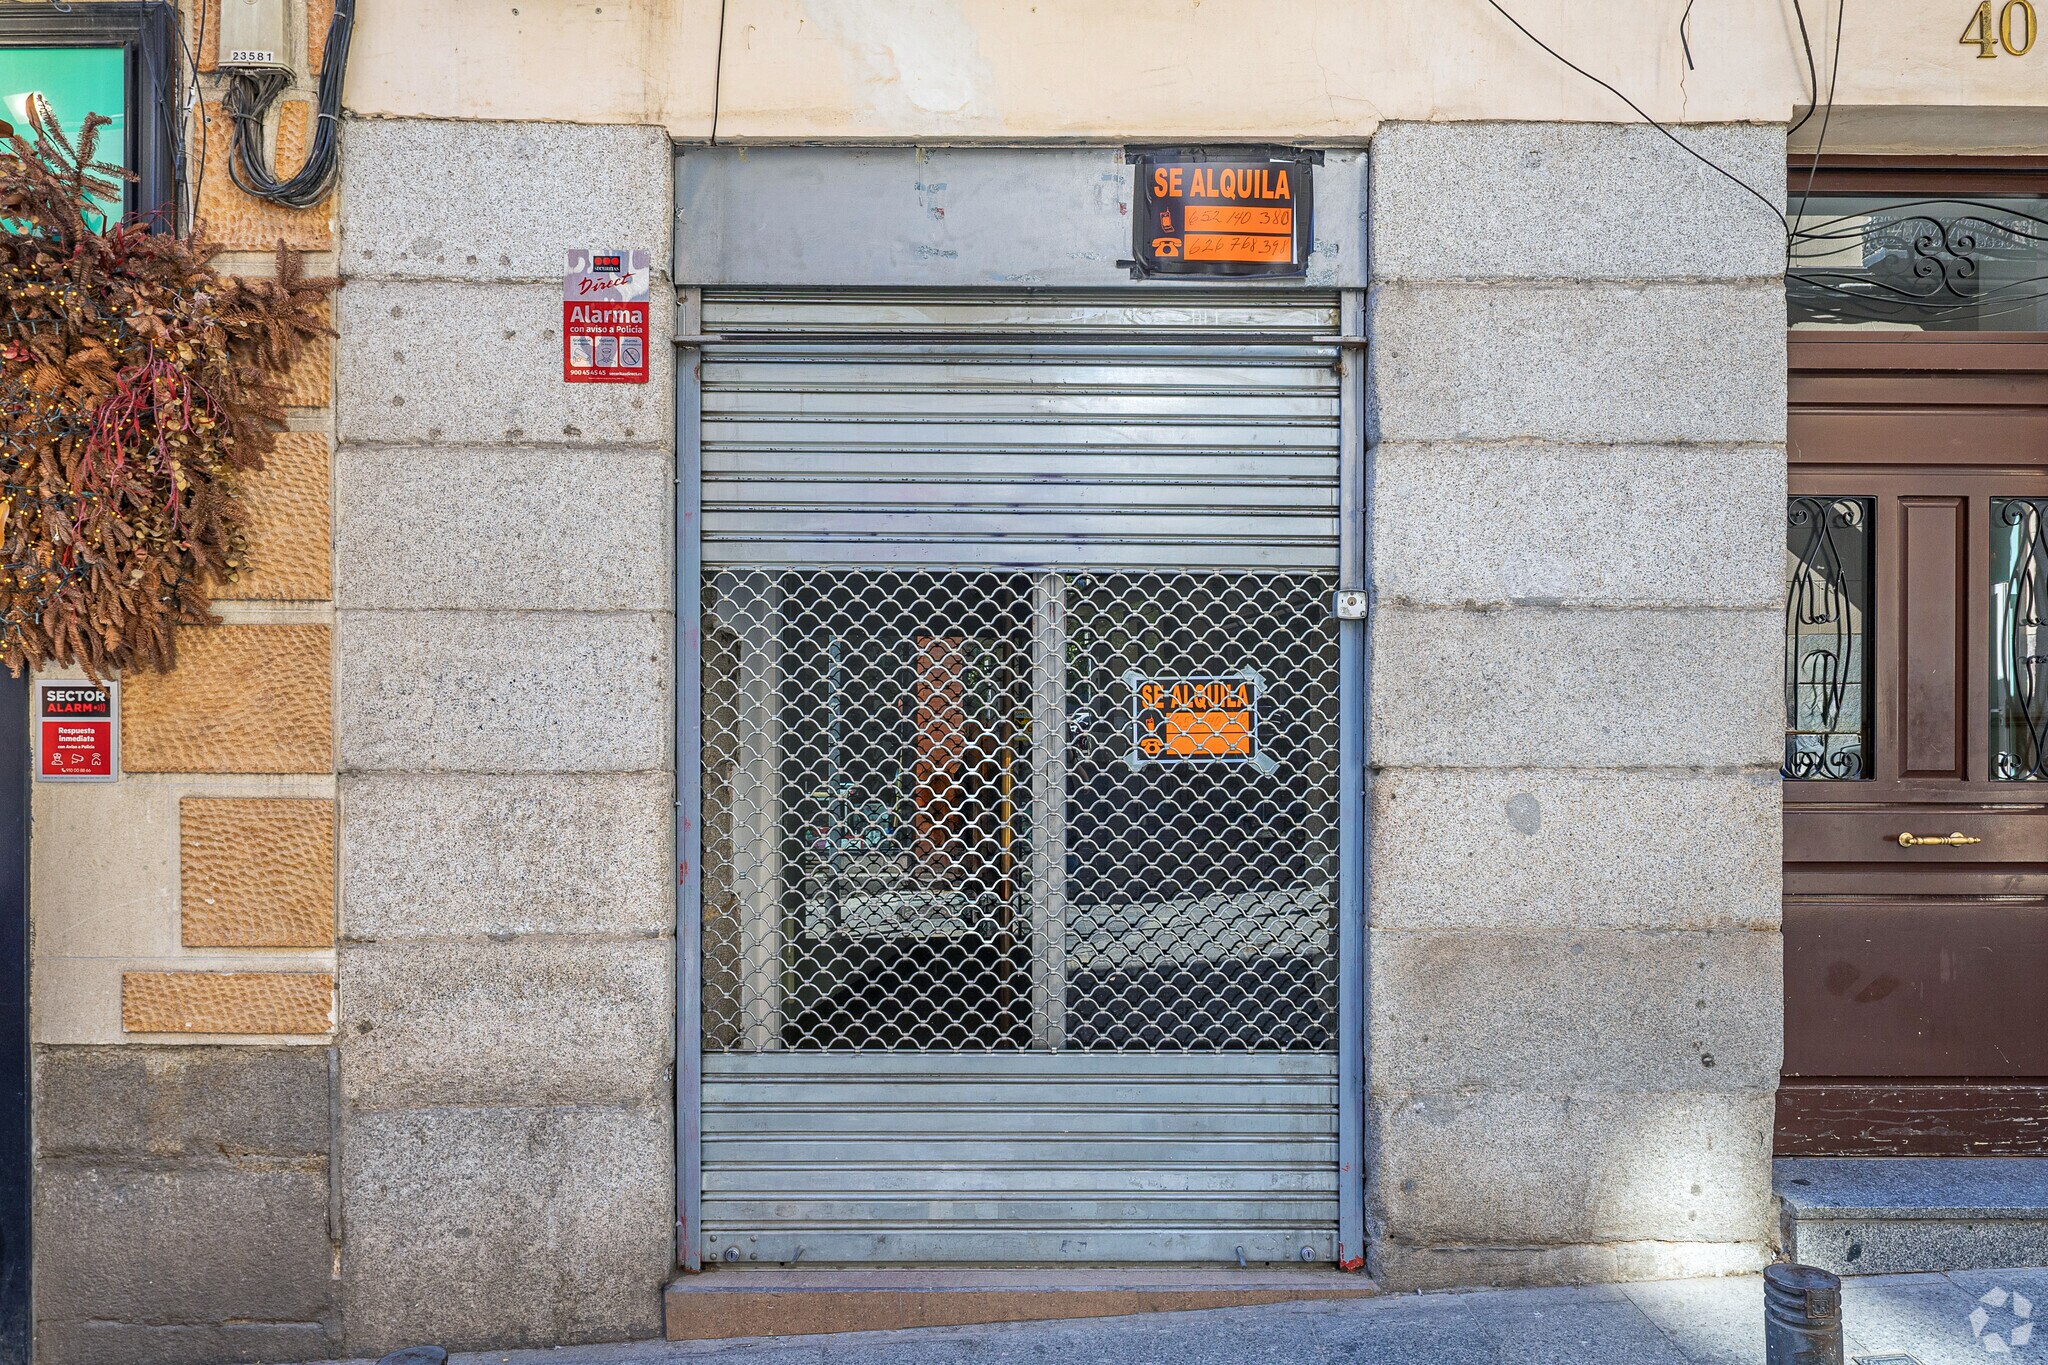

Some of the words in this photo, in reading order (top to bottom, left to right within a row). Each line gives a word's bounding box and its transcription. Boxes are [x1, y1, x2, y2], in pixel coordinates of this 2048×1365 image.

[1959, 0, 2037, 58] 40
[233, 52, 272, 61] 23581
[1154, 168, 1183, 198] SE
[1189, 168, 1290, 200] ALQUILA
[1188, 211, 1222, 226] 652
[1226, 211, 1251, 226] 140
[1259, 210, 1289, 226] 380
[1188, 238, 1224, 255] 626
[578, 272, 636, 295] Direct
[570, 305, 643, 324] Alarma
[586, 325, 608, 333] aviso
[616, 325, 643, 333] Policía
[47, 690, 106, 702] SECTOR
[1142, 684, 1165, 709] SE
[1170, 683, 1249, 710] ALQUILA
[47, 703, 93, 713] ALARM
[58, 727, 95, 736] Respuesta
